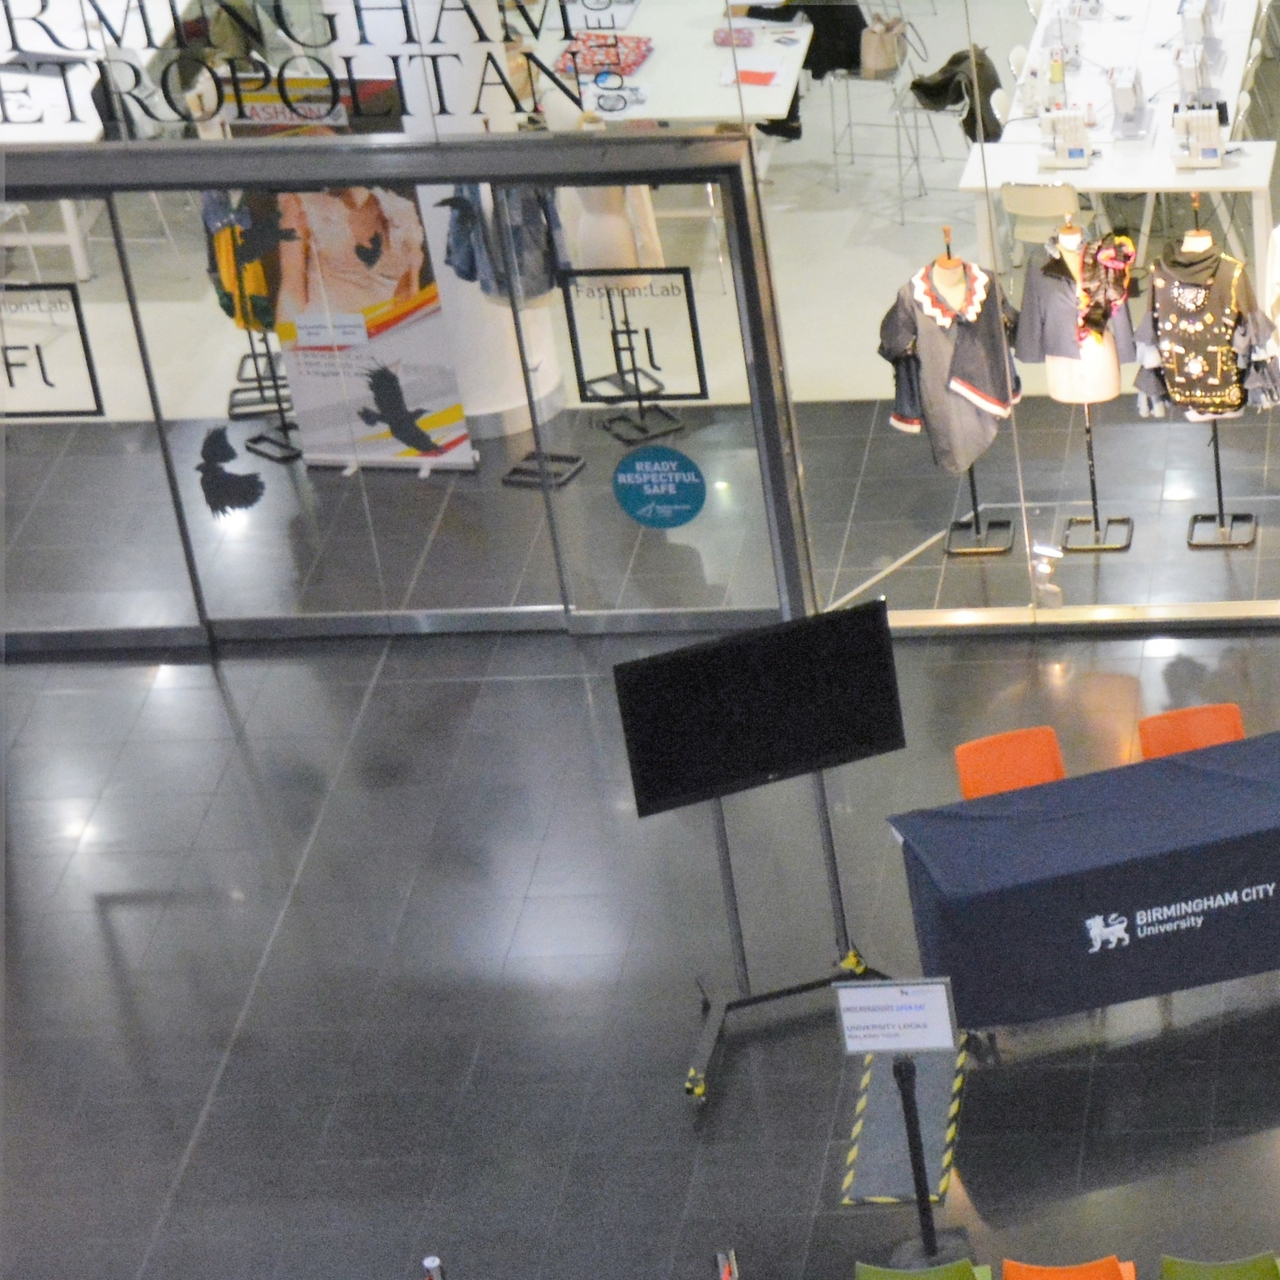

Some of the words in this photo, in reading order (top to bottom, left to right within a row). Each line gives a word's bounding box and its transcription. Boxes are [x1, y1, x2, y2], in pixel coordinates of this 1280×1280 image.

[635, 461, 678, 472] READY
[617, 472, 699, 484] RESPECTFUL
[643, 483, 677, 495] SAFE
[1136, 889, 1239, 926] BIRMINGHAM
[1241, 882, 1276, 902] CITY
[1137, 915, 1204, 939] University
